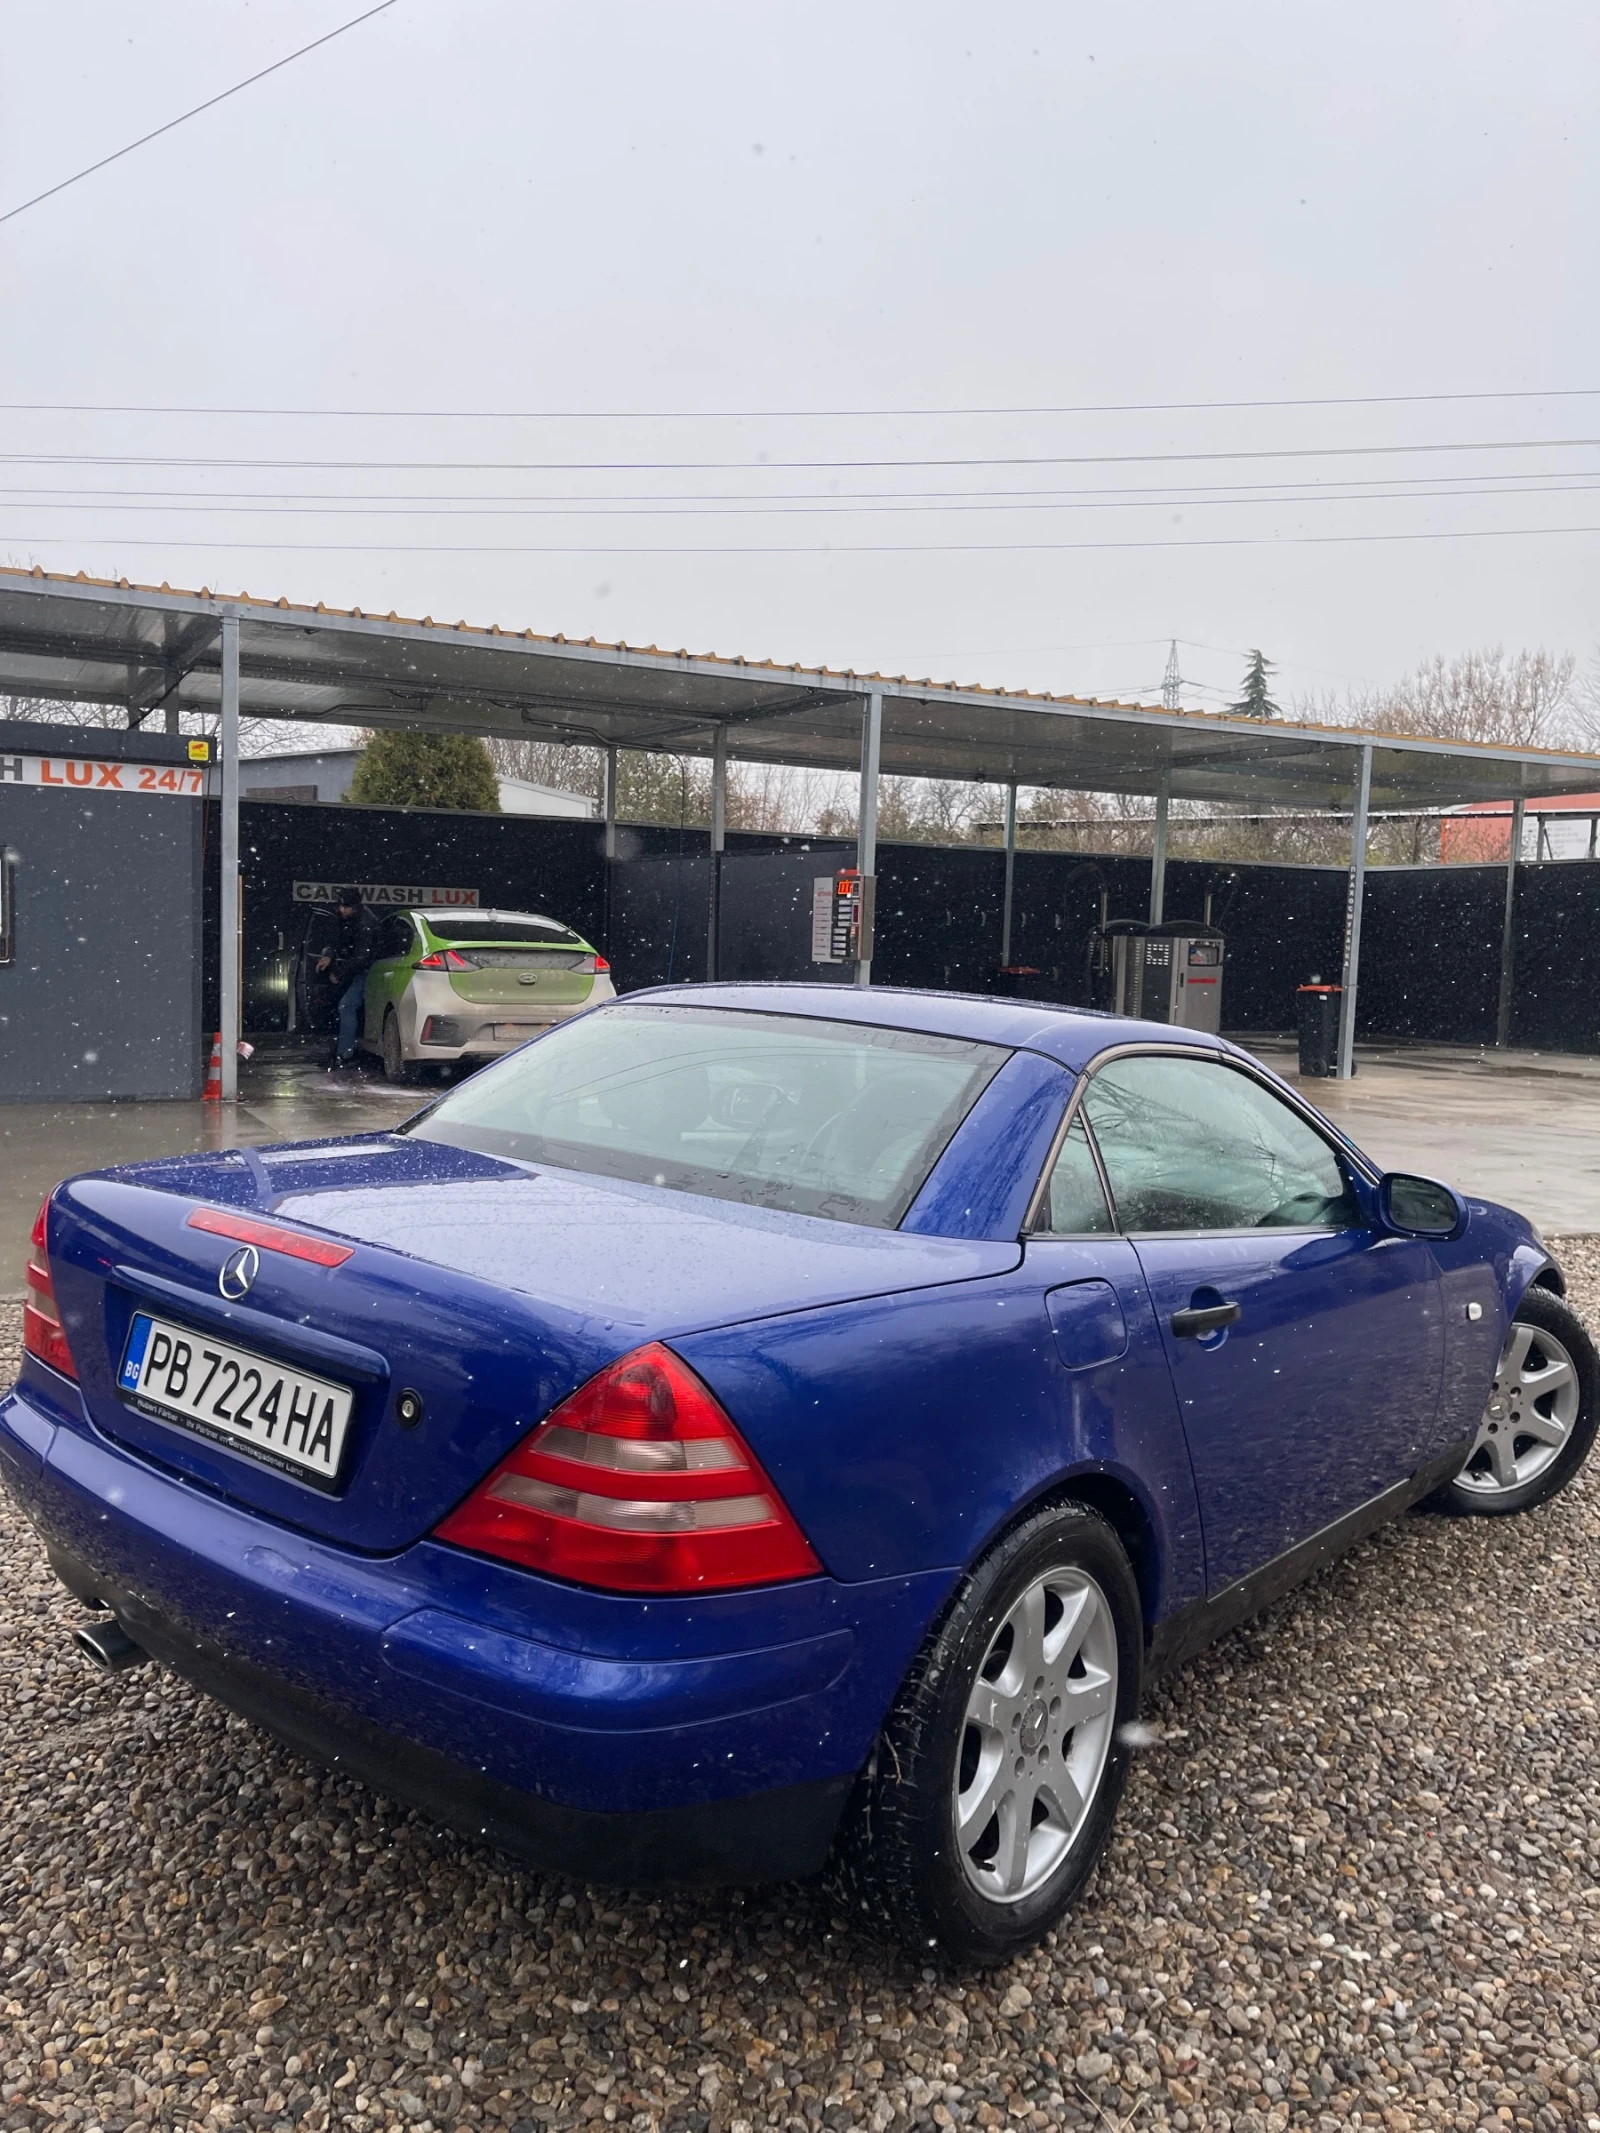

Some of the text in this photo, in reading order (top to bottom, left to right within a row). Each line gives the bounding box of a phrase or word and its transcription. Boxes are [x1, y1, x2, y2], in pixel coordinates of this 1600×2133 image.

[41, 760, 124, 789] LUX
[138, 768, 204, 793] 24/7
[357, 887, 423, 904] WASH
[432, 889, 477, 906] LUX
[124, 1359, 140, 1380] BG
[143, 1331, 336, 1464] PB 7224 HA
